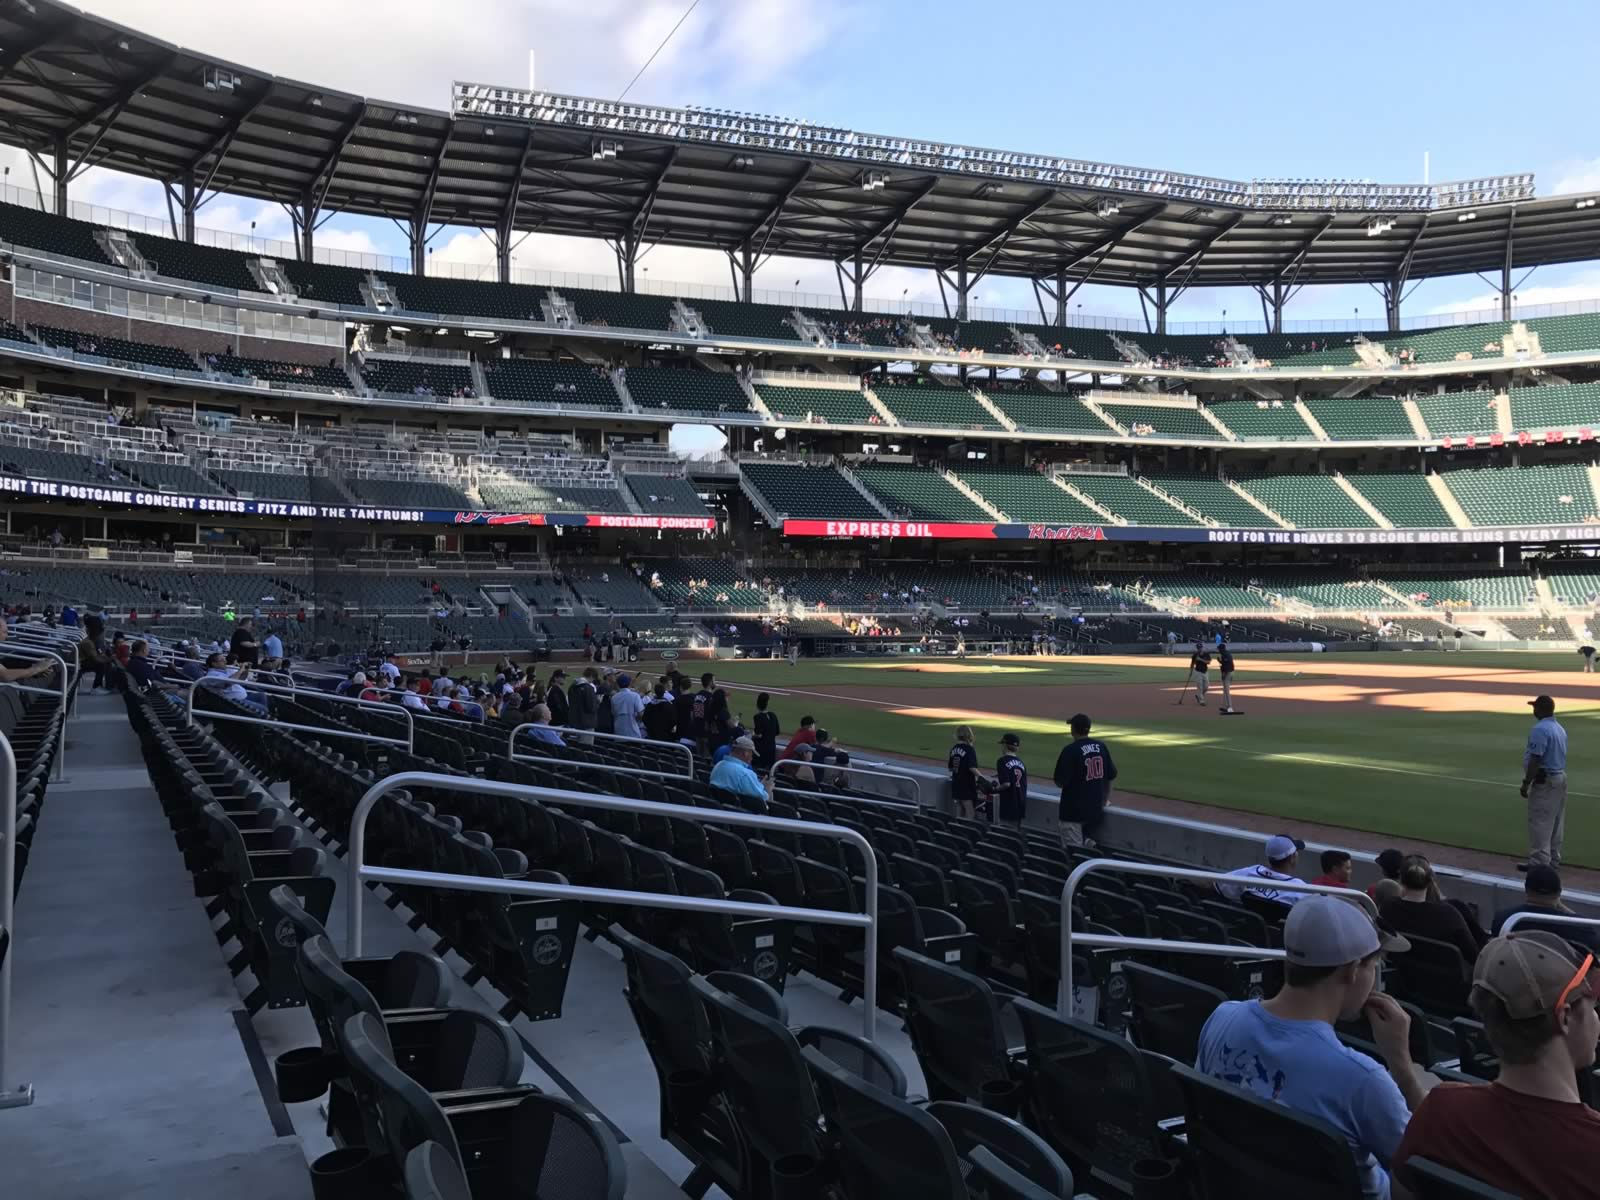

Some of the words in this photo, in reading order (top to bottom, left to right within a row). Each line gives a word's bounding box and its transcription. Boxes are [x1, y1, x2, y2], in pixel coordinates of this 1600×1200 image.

[31, 481, 57, 496] THE
[61, 486, 131, 503] POSTGAME
[135, 493, 195, 509] CONCERT
[199, 499, 245, 512] SERIES
[258, 503, 287, 515] FITZ
[291, 505, 317, 517] AND
[321, 507, 346, 518] THE
[350, 508, 424, 521] TANTRUMS!
[600, 516, 659, 527] POSTGAME
[661, 518, 710, 528] CONCERT
[827, 522, 900, 536] EXPRESS
[906, 524, 933, 537] OIL
[1209, 531, 1238, 541] ROOT
[1243, 532, 1265, 542] FOR
[1269, 533, 1290, 543] THE
[1293, 532, 1343, 543] BRAVES
[1348, 533, 1366, 542] TO
[1370, 532, 1414, 543] SCORE
[1418, 532, 1458, 542] MORE
[1462, 531, 1505, 542] RUNS
[1509, 530, 1560, 542] EVERY
[1081, 743, 1101, 756] JONES
[1085, 756, 1104, 781] 10
